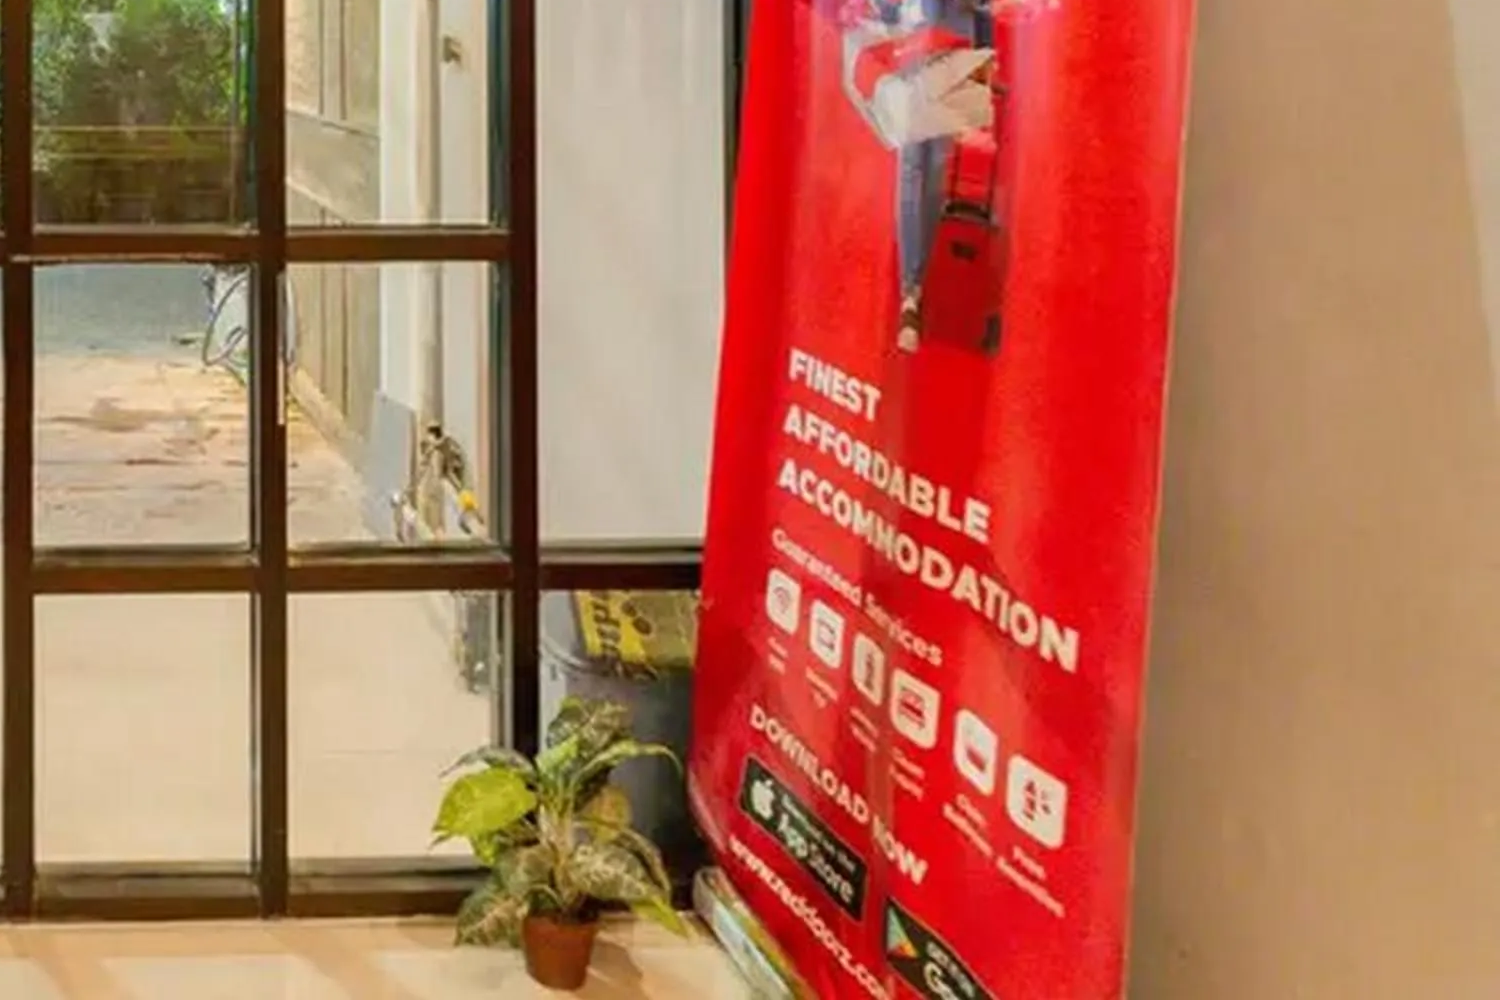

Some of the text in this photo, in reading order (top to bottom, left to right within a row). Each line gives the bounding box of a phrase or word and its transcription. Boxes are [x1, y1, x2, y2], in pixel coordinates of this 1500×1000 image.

[788, 347, 882, 422] FINEST
[783, 403, 992, 545] AFFORDABLE
[777, 457, 1080, 674] ACCOMMODATION
[750, 703, 869, 825] DOWNLOAD
[872, 814, 928, 885] NOW
